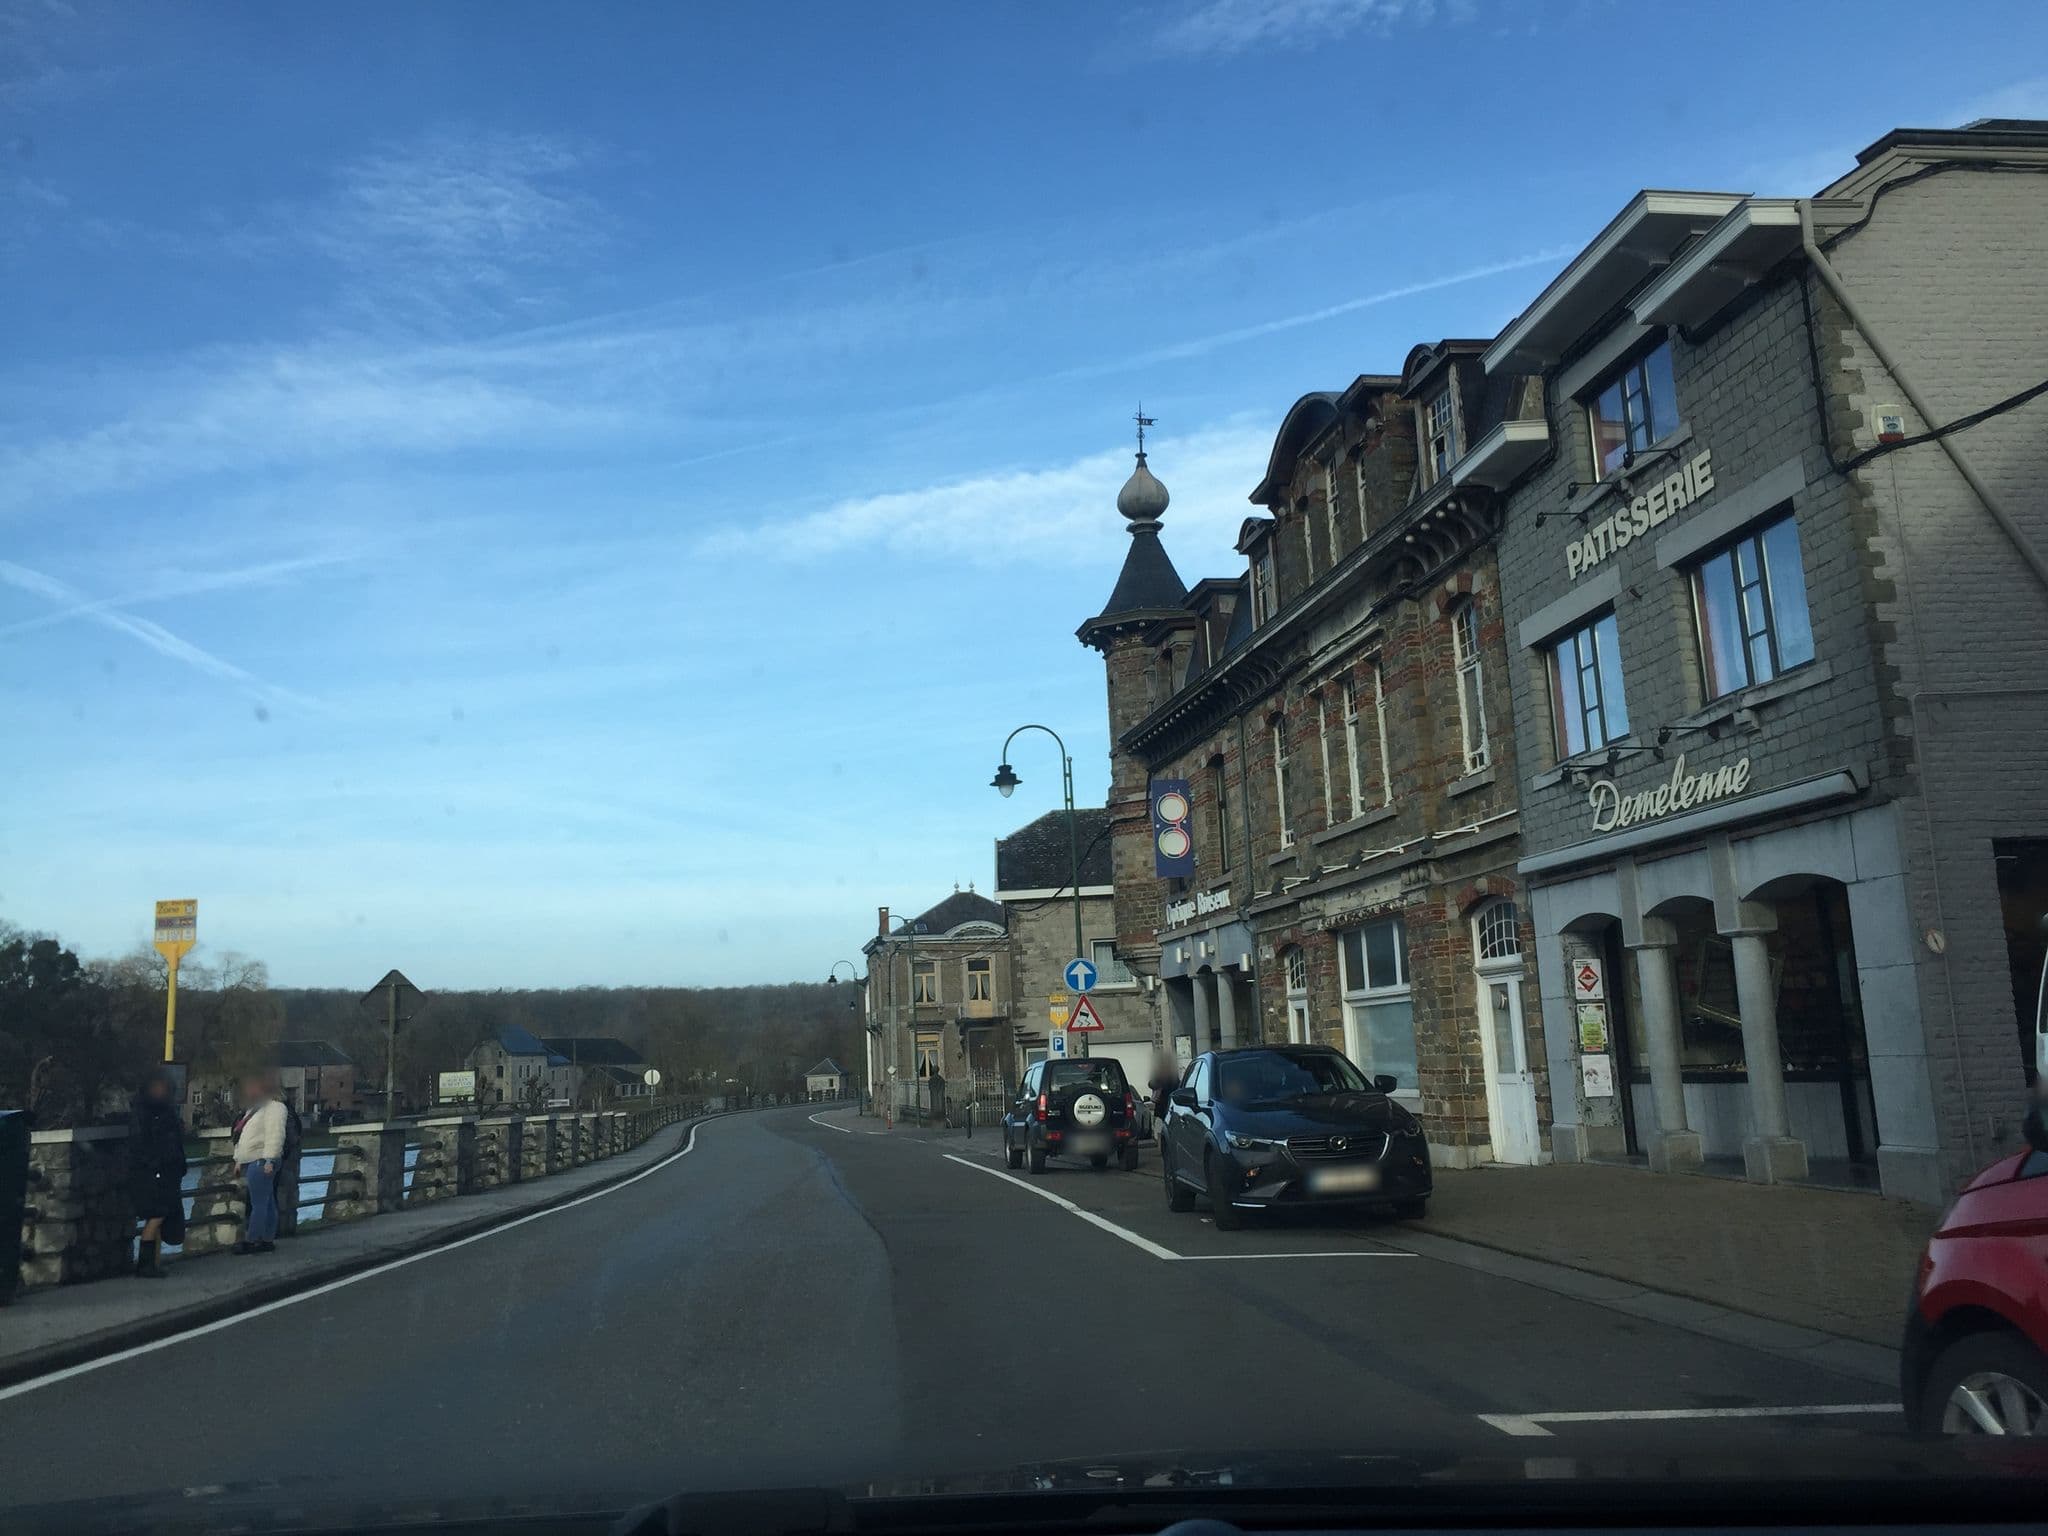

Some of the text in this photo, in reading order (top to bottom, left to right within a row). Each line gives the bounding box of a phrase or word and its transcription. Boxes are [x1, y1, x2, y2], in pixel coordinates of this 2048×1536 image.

[1566, 449, 1715, 580] PATISSERIE
[1589, 753, 1750, 832] Demelenne
[1166, 901, 1196, 930] Optique
